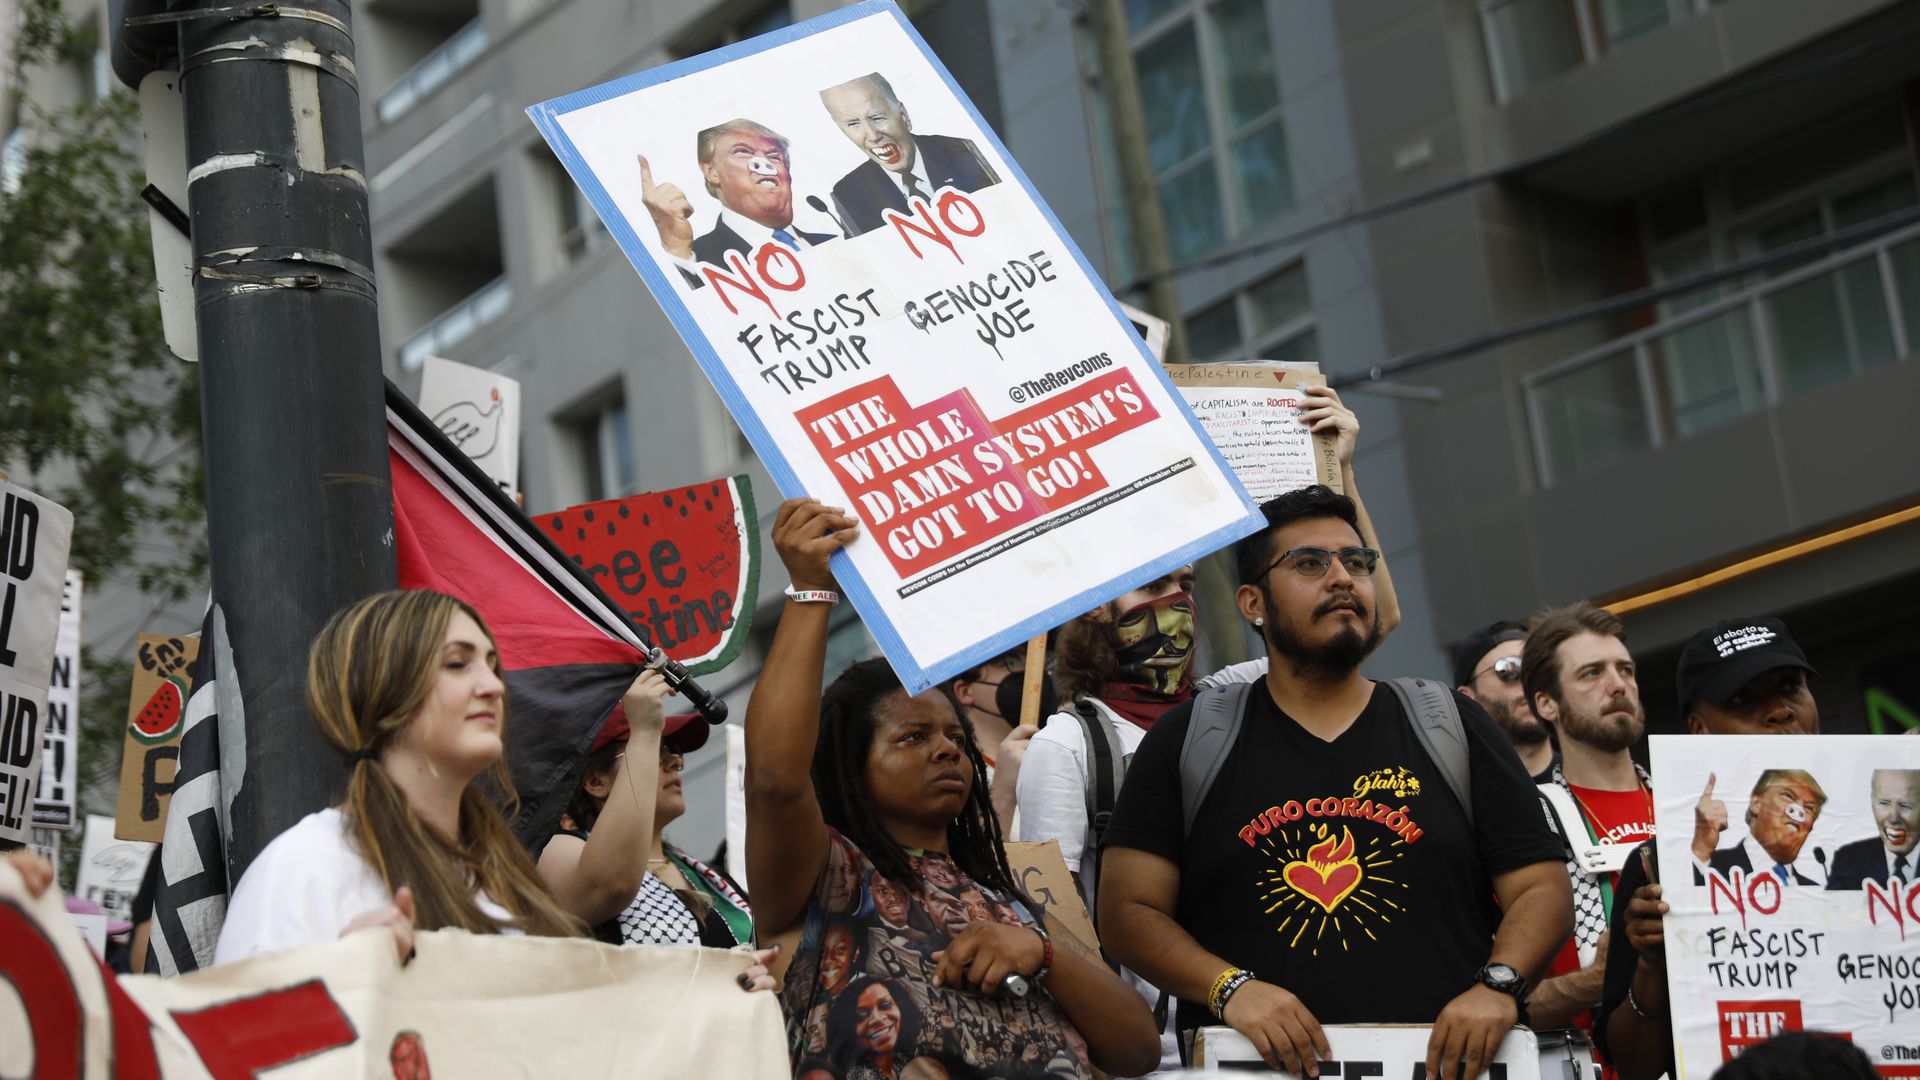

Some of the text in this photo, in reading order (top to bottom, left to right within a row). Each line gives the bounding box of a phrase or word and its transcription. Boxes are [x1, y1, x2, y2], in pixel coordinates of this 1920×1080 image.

[888, 190, 986, 265] NO
[702, 242, 806, 321] NO
[903, 250, 1057, 335] GENOCIDE
[737, 288, 881, 365] FASCIST
[976, 298, 1035, 361] JOE
[759, 335, 871, 395] TRUMP
[1009, 352, 1113, 404] @TheRevcoms
[810, 395, 897, 450] THE
[1201, 399, 1249, 410] CAPITALISM
[834, 408, 975, 485] WHOLE
[858, 382, 1144, 527] DAMN SYSTEM'S
[887, 450, 1093, 560] GOT TO GO!
[572, 540, 687, 595] ree
[946, 565, 955, 573] for
[955, 560, 966, 569] the
[1008, 529, 1036, 546] Humanity
[1713, 634, 1723, 645] El
[1723, 626, 1757, 640] aborto
[1238, 796, 1425, 848] PURO CORAZÓN
[1600, 822, 1657, 846] OCIALIS
[1709, 870, 1782, 931] NO
[1706, 926, 1825, 958] FASCIST
[1708, 960, 1798, 989] TRUMP
[1883, 981, 1920, 1023] JO
[1881, 1045, 1920, 1061] @The
